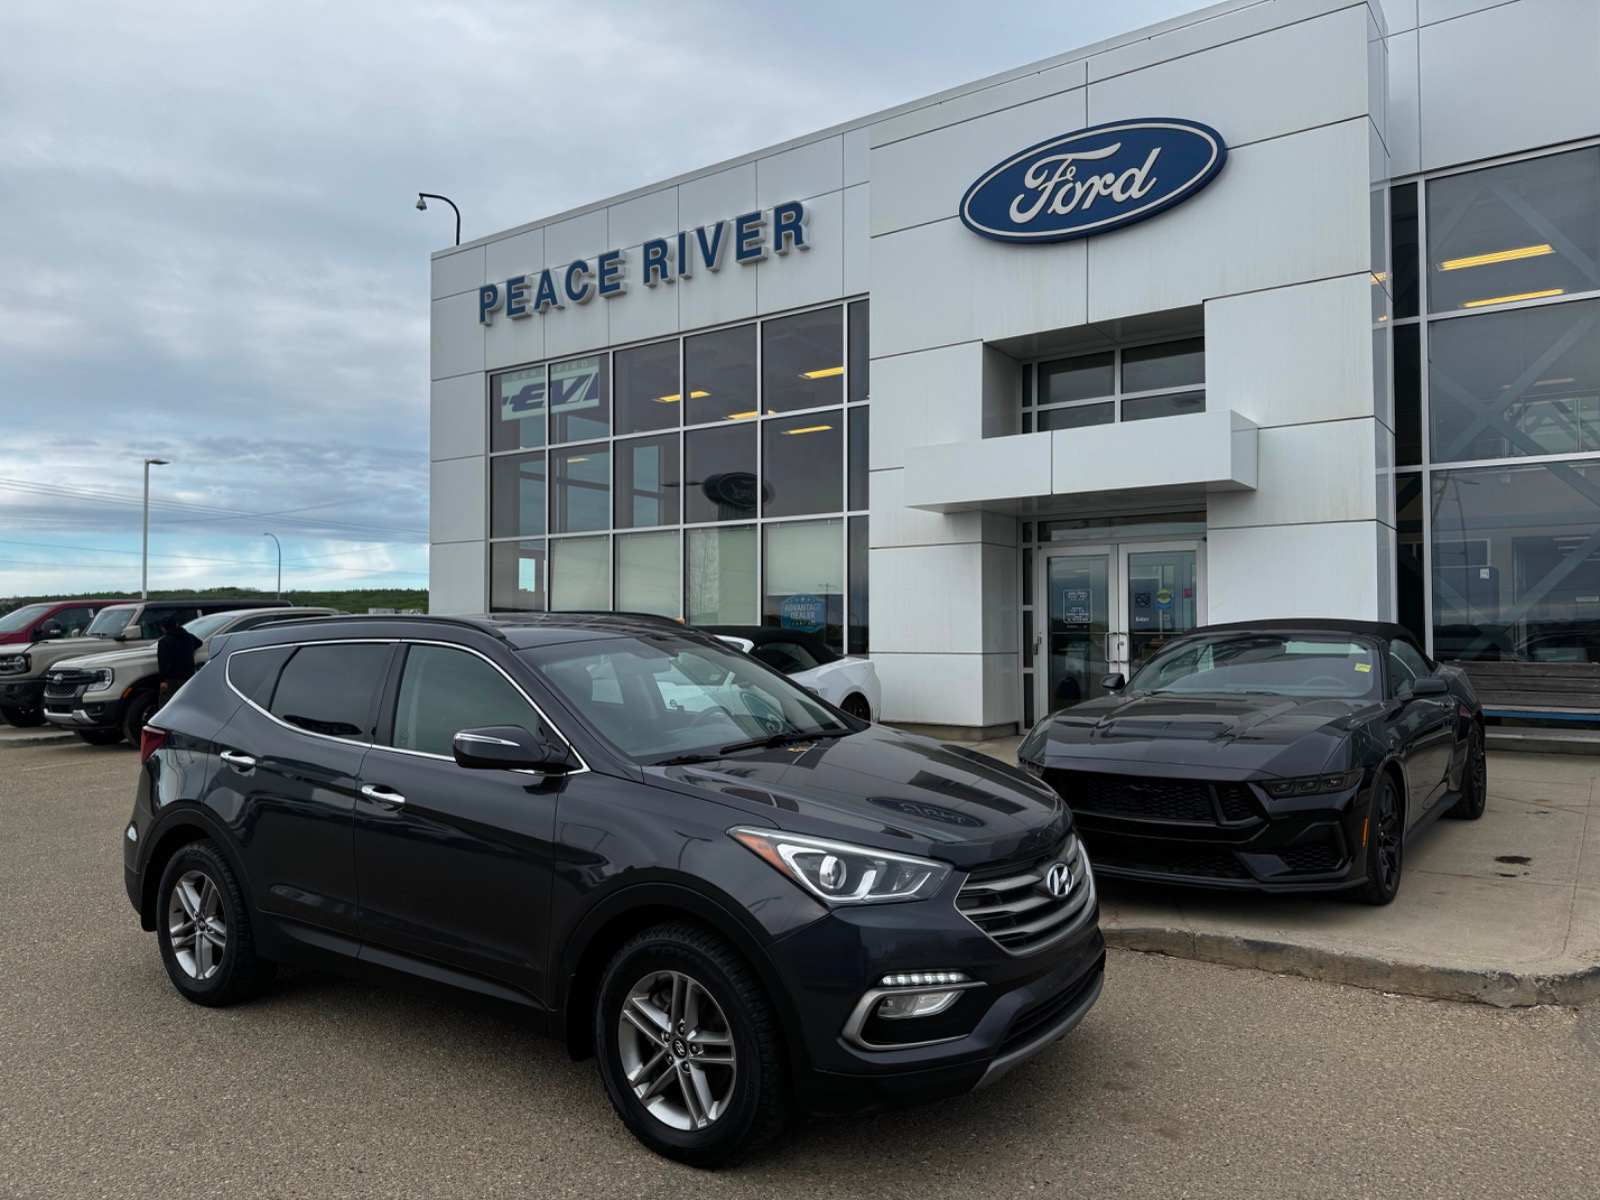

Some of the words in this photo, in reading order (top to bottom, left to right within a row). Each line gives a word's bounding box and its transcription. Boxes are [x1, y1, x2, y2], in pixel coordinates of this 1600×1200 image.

[1009, 142, 1162, 224] Ford
[479, 250, 624, 325] PEACE
[643, 200, 808, 288] RIVER
